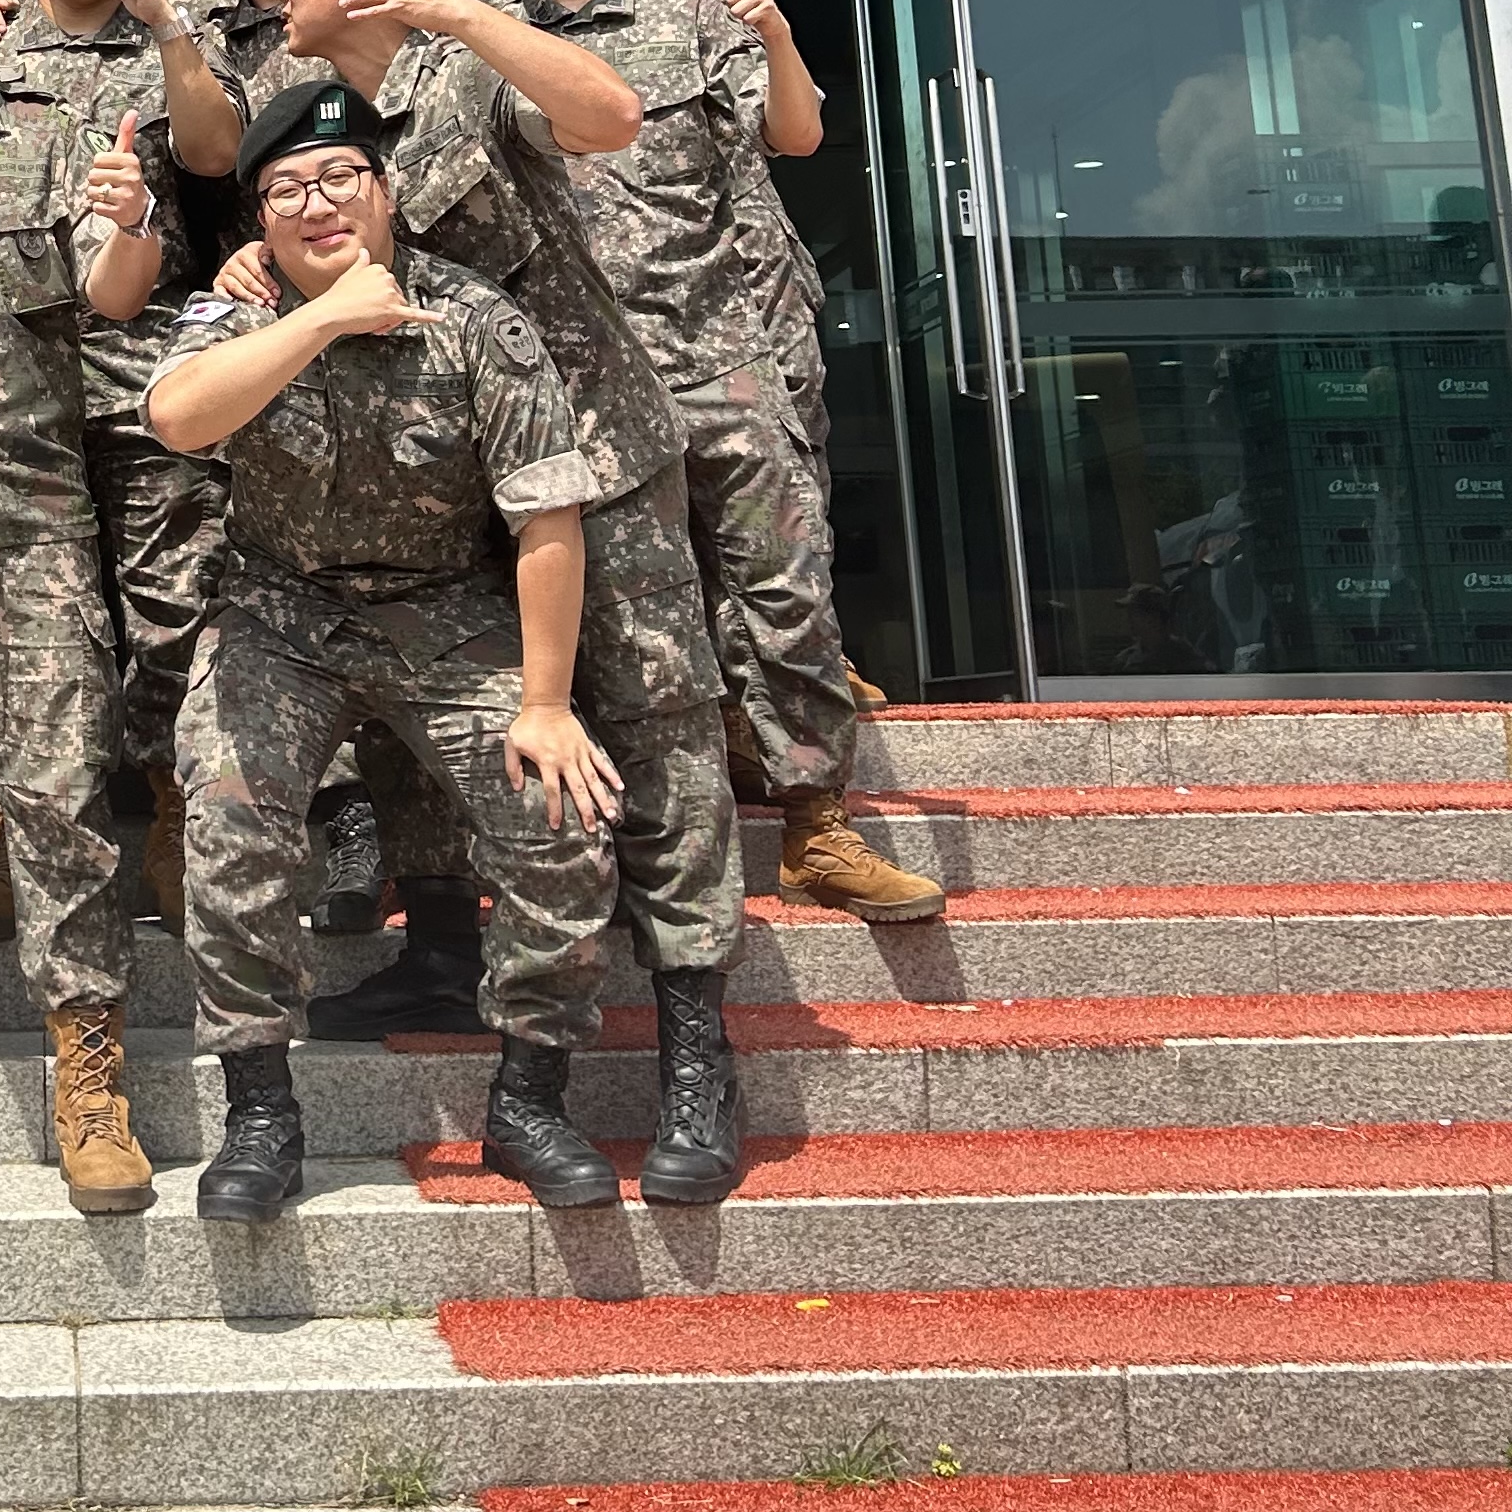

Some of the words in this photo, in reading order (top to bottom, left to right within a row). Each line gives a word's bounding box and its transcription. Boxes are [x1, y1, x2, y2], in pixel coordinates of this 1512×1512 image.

[1309, 194, 1344, 206] 빙그레
[1331, 382, 1368, 395] 빙그레
[1453, 379, 1489, 393] 빙그레
[1343, 480, 1380, 493] 빙그레
[1469, 479, 1503, 492] 빙그레
[1352, 578, 1390, 592] 빙그레
